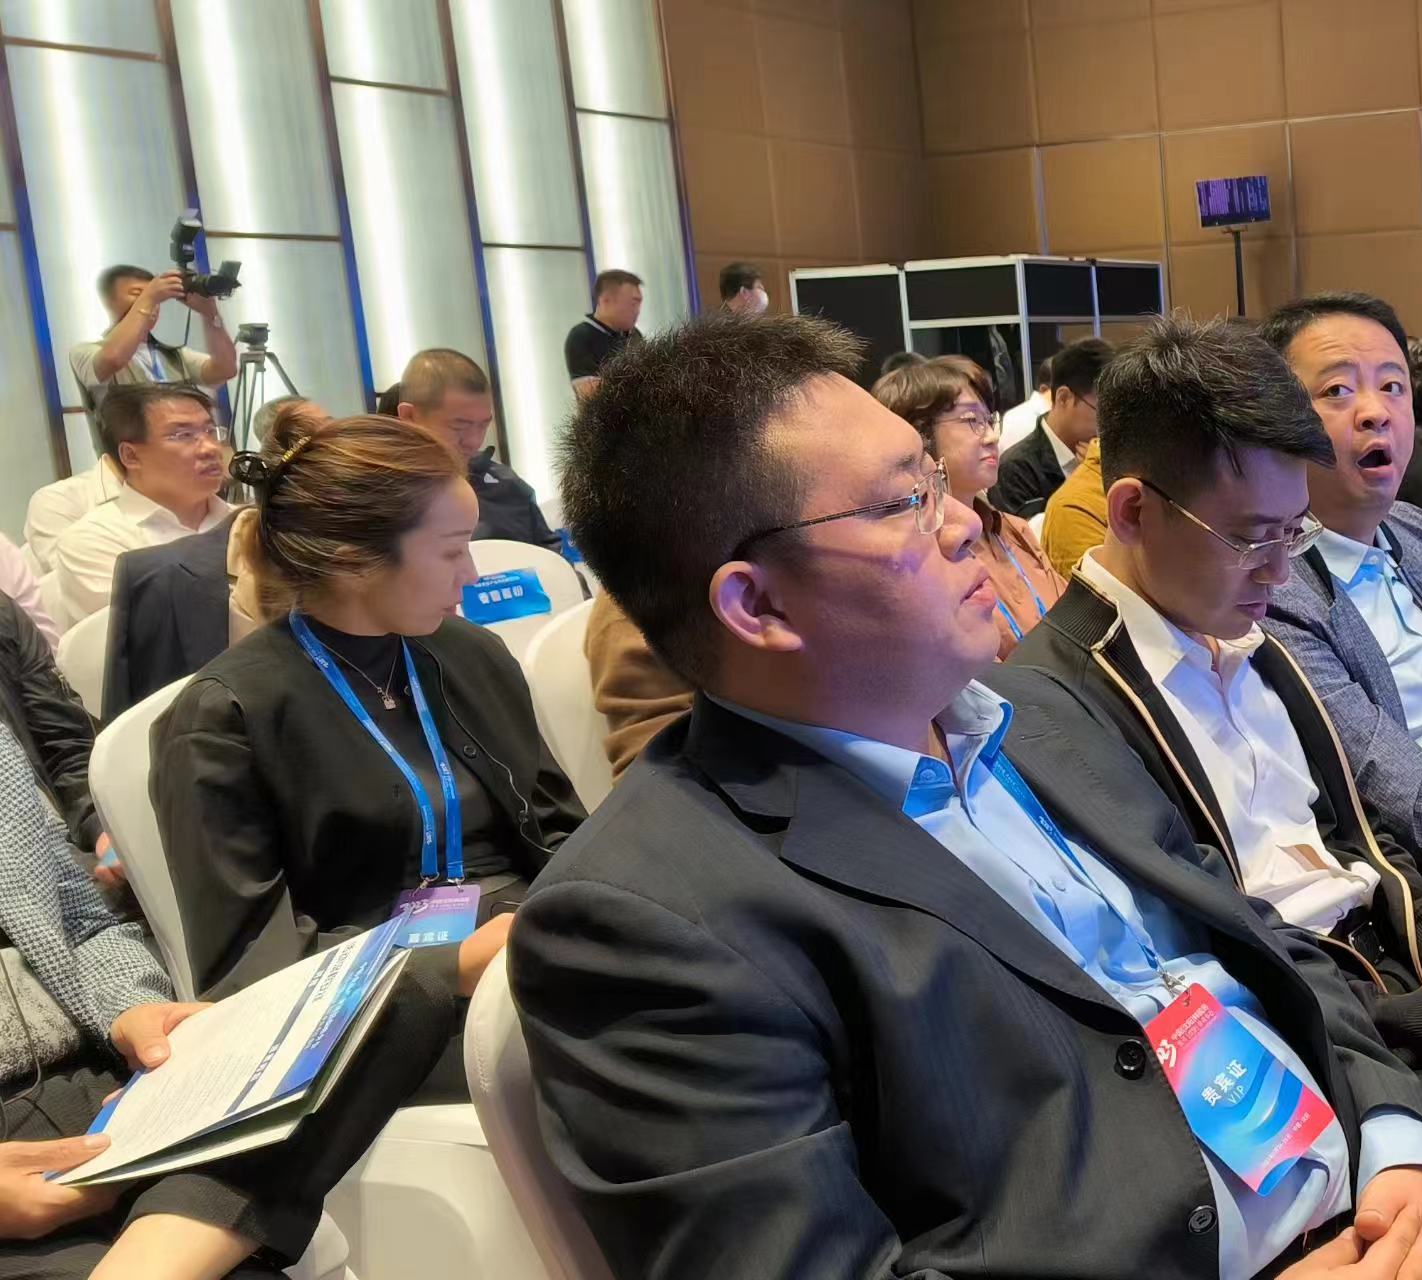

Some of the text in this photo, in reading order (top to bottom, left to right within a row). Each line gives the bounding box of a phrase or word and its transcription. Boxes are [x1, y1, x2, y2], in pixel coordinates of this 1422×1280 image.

[1201, 1059, 1248, 1107] 贵宾证
[1227, 1085, 1245, 1105] VIP
